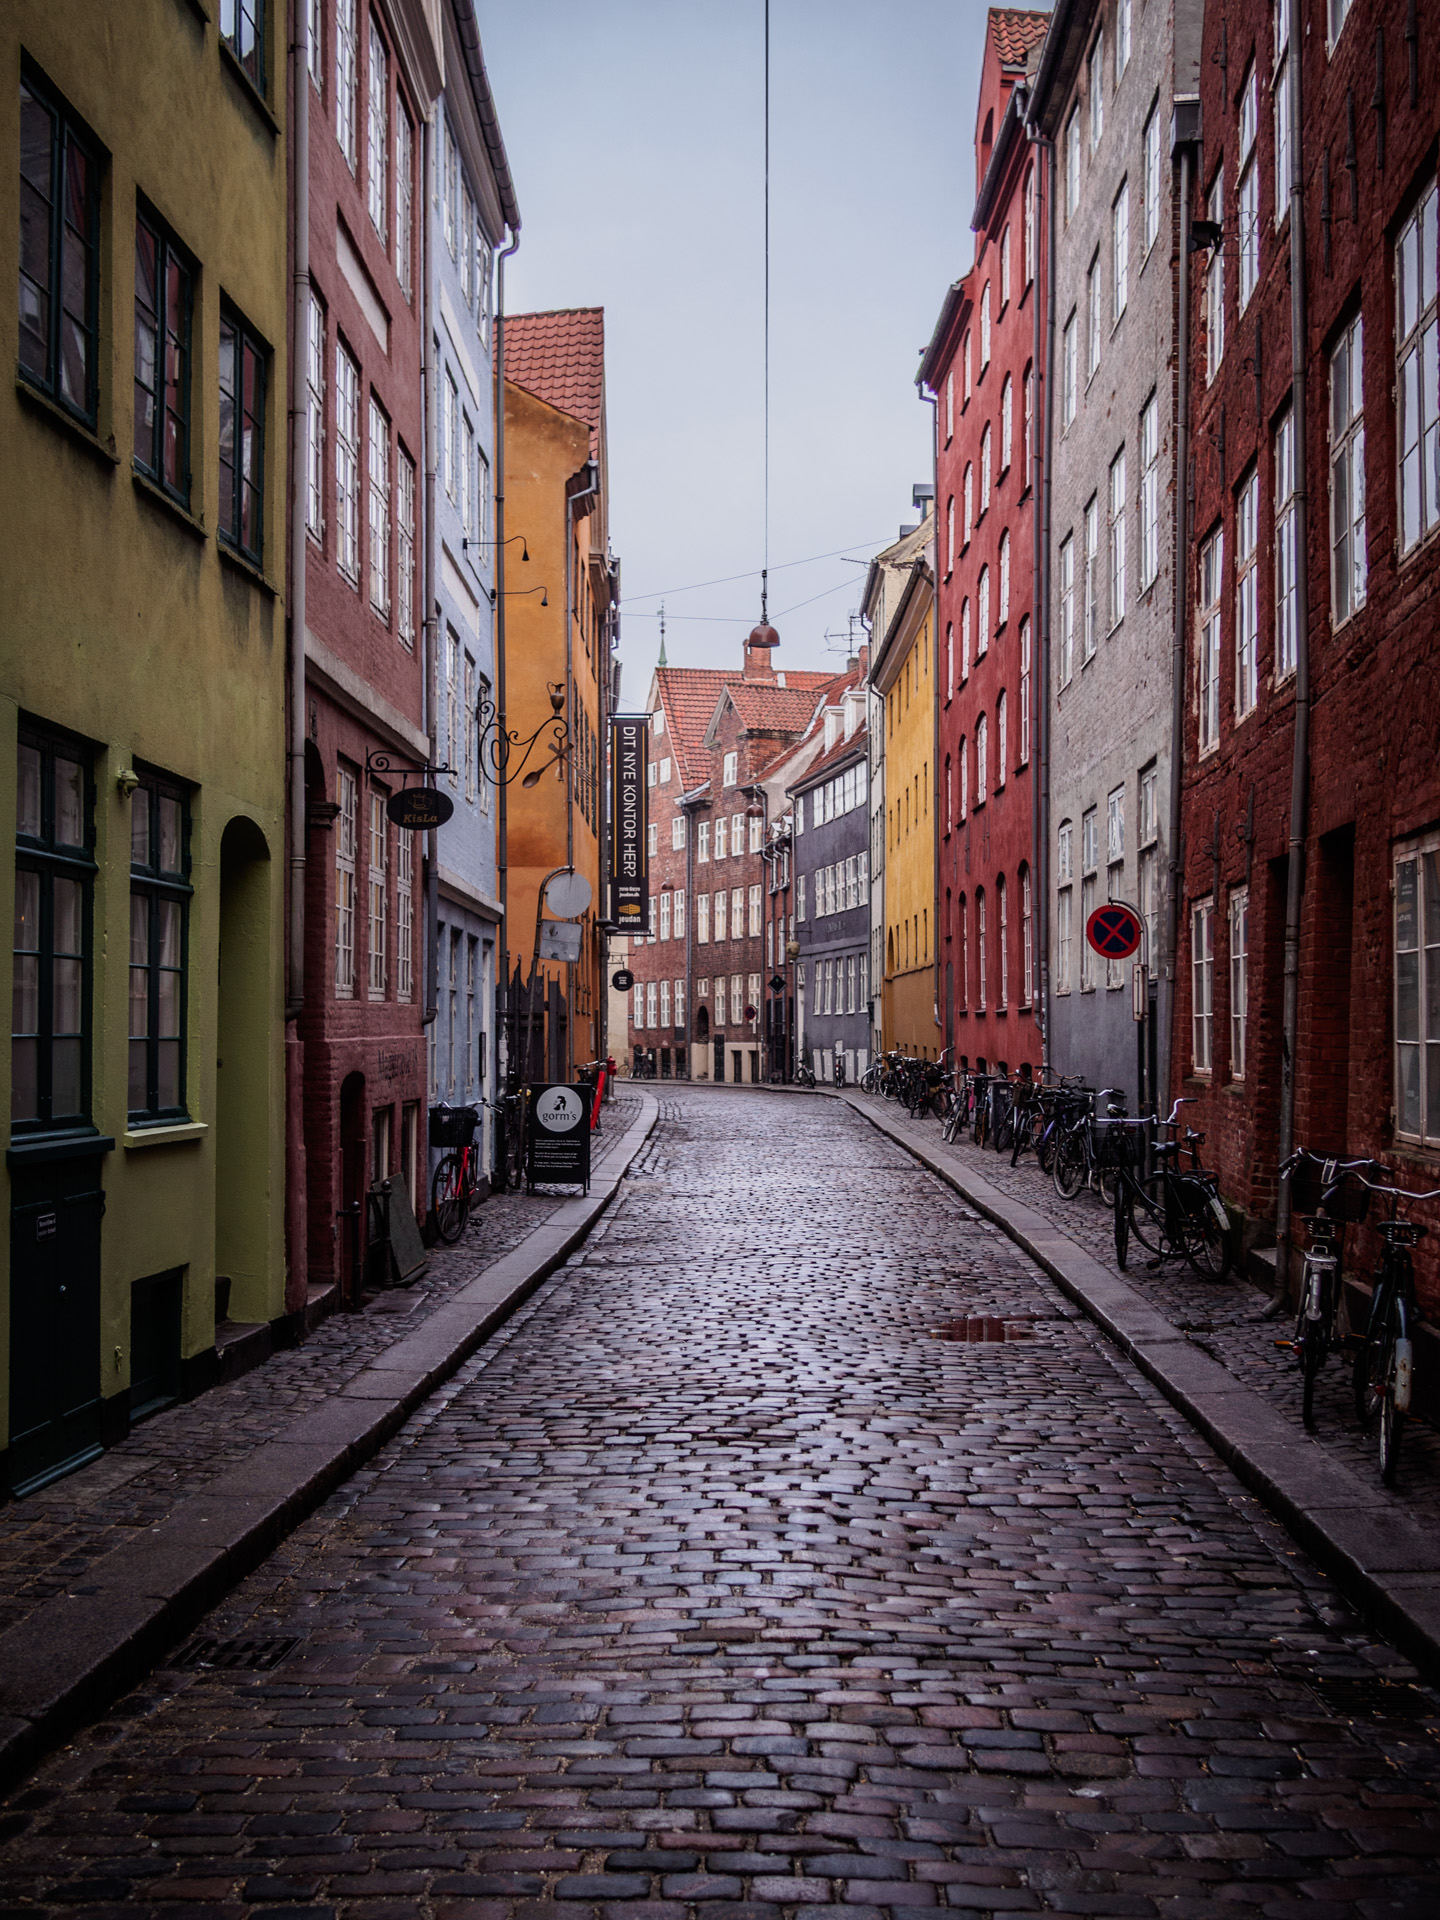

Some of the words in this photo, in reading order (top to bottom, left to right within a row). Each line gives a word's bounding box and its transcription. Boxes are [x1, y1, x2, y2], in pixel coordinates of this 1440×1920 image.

[623, 726, 636, 748] DIT
[623, 752, 637, 780] NYE
[403, 813, 438, 823] KisLa
[623, 785, 637, 839] KONTOR
[623, 843, 637, 878] HER?
[542, 1110, 577, 1123] gorm's
